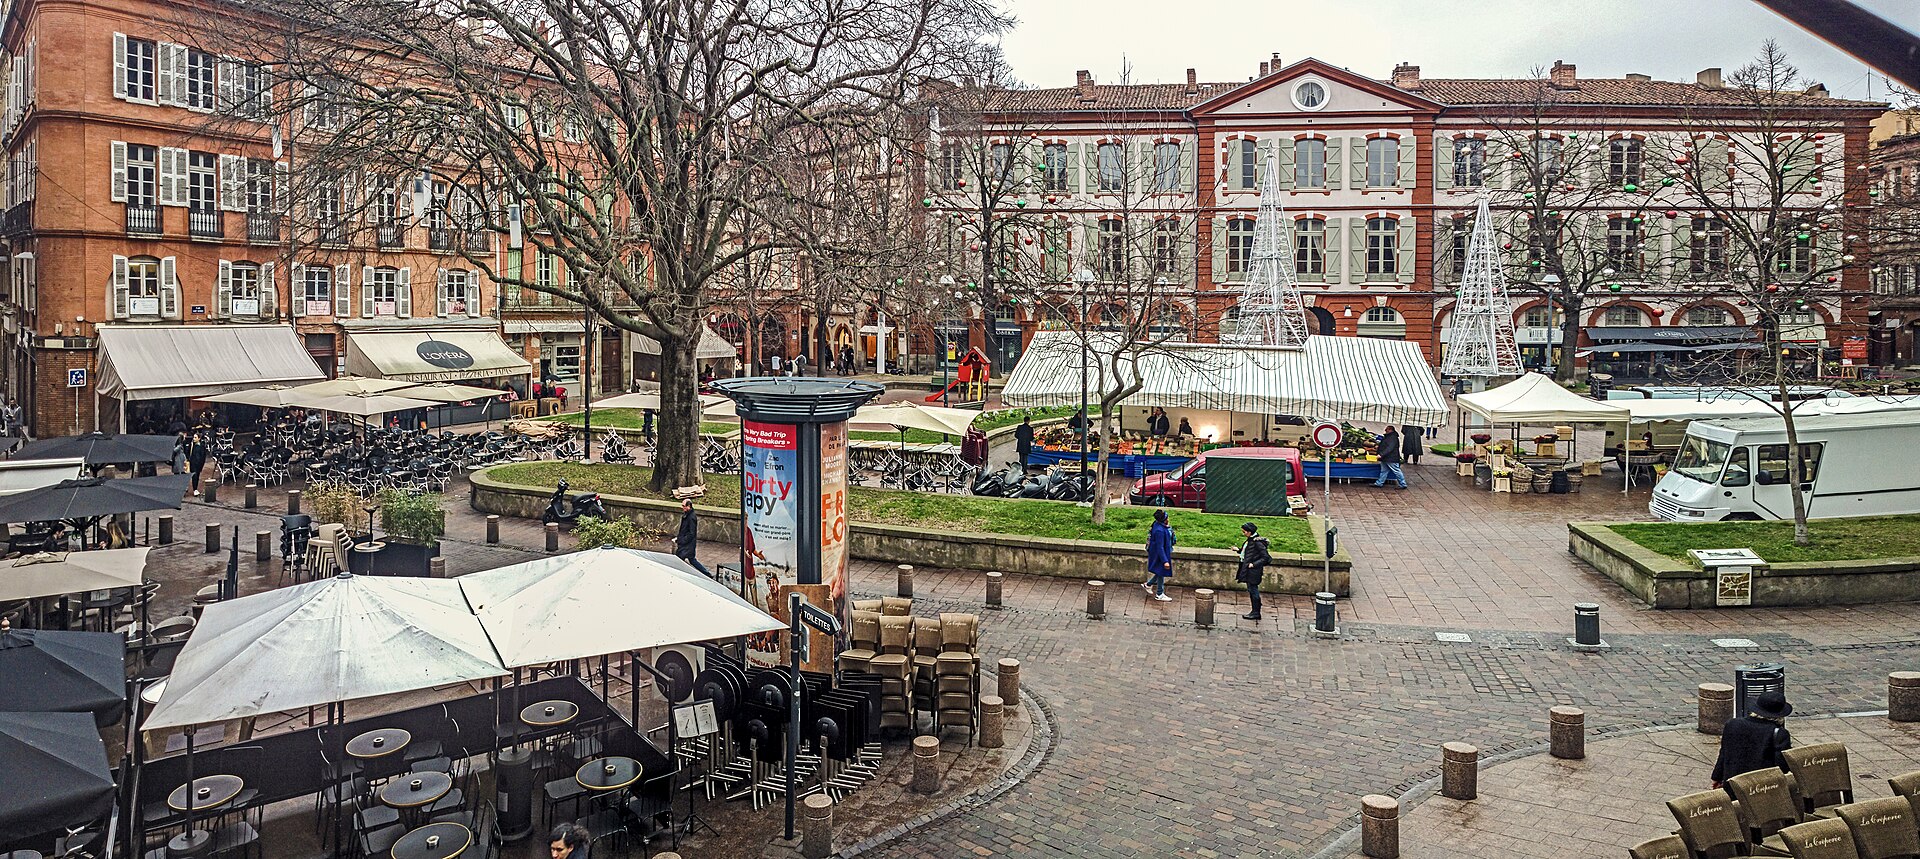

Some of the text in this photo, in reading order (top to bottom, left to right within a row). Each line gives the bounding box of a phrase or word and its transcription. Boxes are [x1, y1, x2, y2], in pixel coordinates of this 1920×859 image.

[420, 351, 468, 360] L'OPÉRA
[406, 372, 452, 382] RESTAURANT
[765, 462, 784, 471] Efron
[746, 472, 792, 500] Dirty
[745, 492, 777, 516] apy
[822, 490, 843, 519] FR
[822, 516, 844, 546] LO
[804, 610, 830, 632] TOILETTES
[1803, 759, 1811, 768] La
[1749, 787, 1755, 795] La
[1690, 808, 1697, 818] La
[1860, 817, 1870, 826] La
[1805, 840, 1813, 849] La
